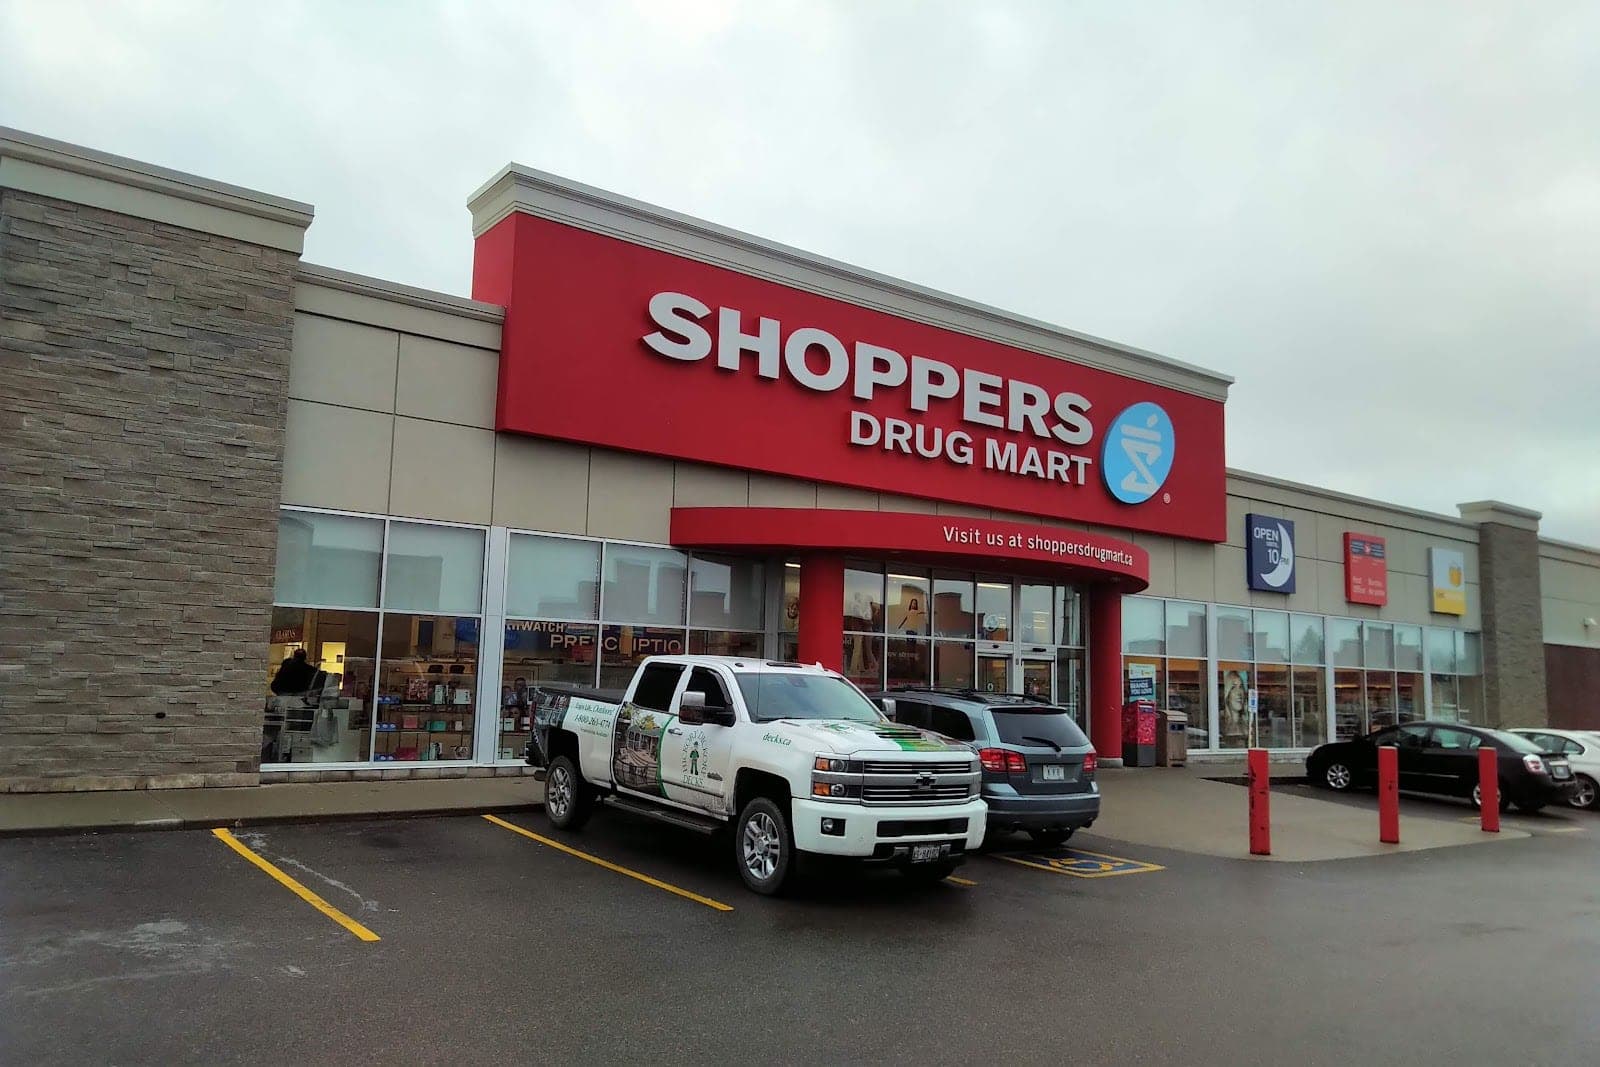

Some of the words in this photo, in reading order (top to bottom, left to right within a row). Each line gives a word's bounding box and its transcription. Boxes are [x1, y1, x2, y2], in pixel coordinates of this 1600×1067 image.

[643, 291, 1093, 445] SHOPPERS
[850, 411, 974, 465] DRUG
[985, 438, 1092, 485] MART
[943, 526, 981, 545] Visit
[986, 533, 1004, 546] us
[1008, 533, 1023, 548] at
[1027, 534, 1133, 566] shoppersdrugmart.ca
[1254, 527, 1279, 542] OPEN
[1267, 548, 1279, 565] 10
[550, 634, 682, 654] PRECIPTIO
